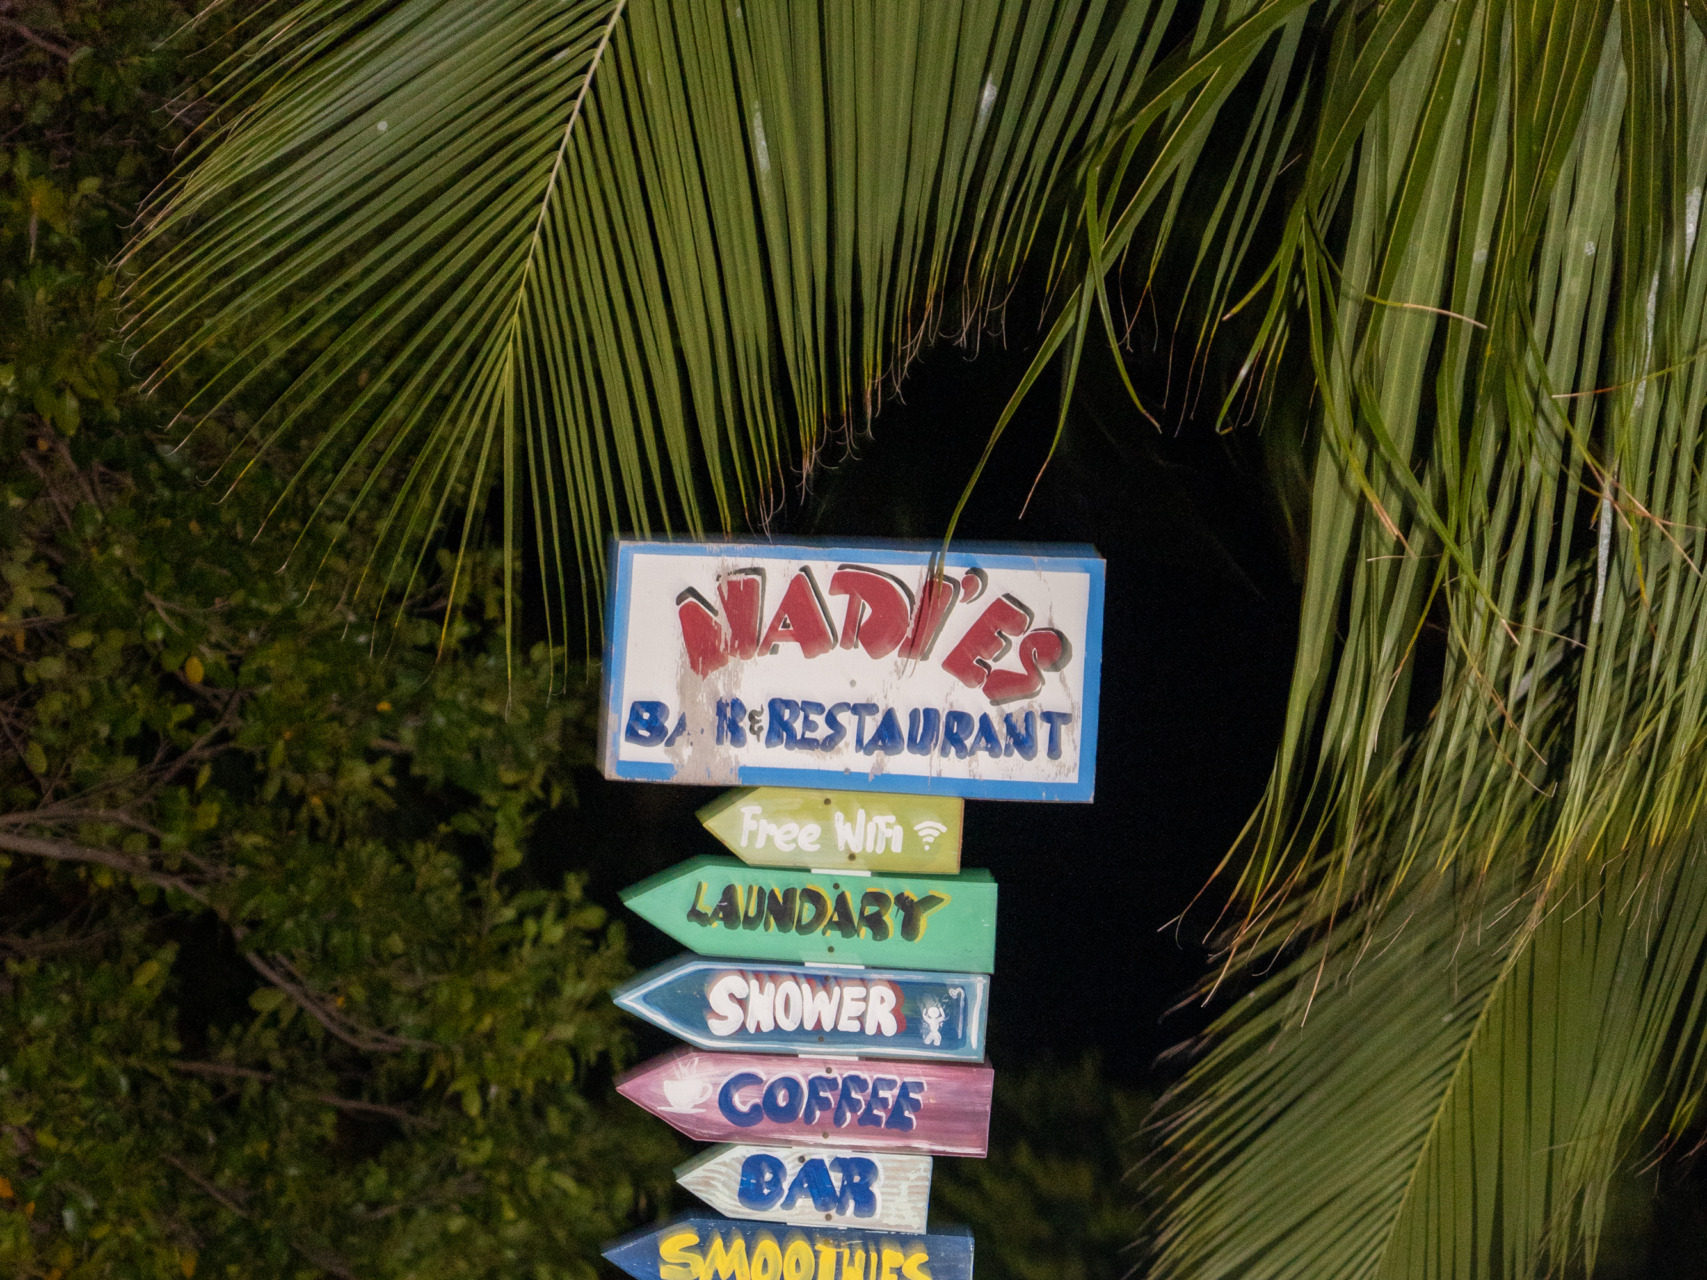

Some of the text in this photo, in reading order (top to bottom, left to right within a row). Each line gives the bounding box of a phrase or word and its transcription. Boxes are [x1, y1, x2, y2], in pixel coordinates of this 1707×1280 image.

[624, 699, 746, 748] BR
[765, 697, 1073, 761] RESTAURANT
[740, 806, 821, 852] Free
[686, 880, 951, 943] LAUNDARY
[706, 972, 905, 1037] SHOWER
[717, 1067, 927, 1132] COFFEE
[738, 1153, 881, 1218] BAR
